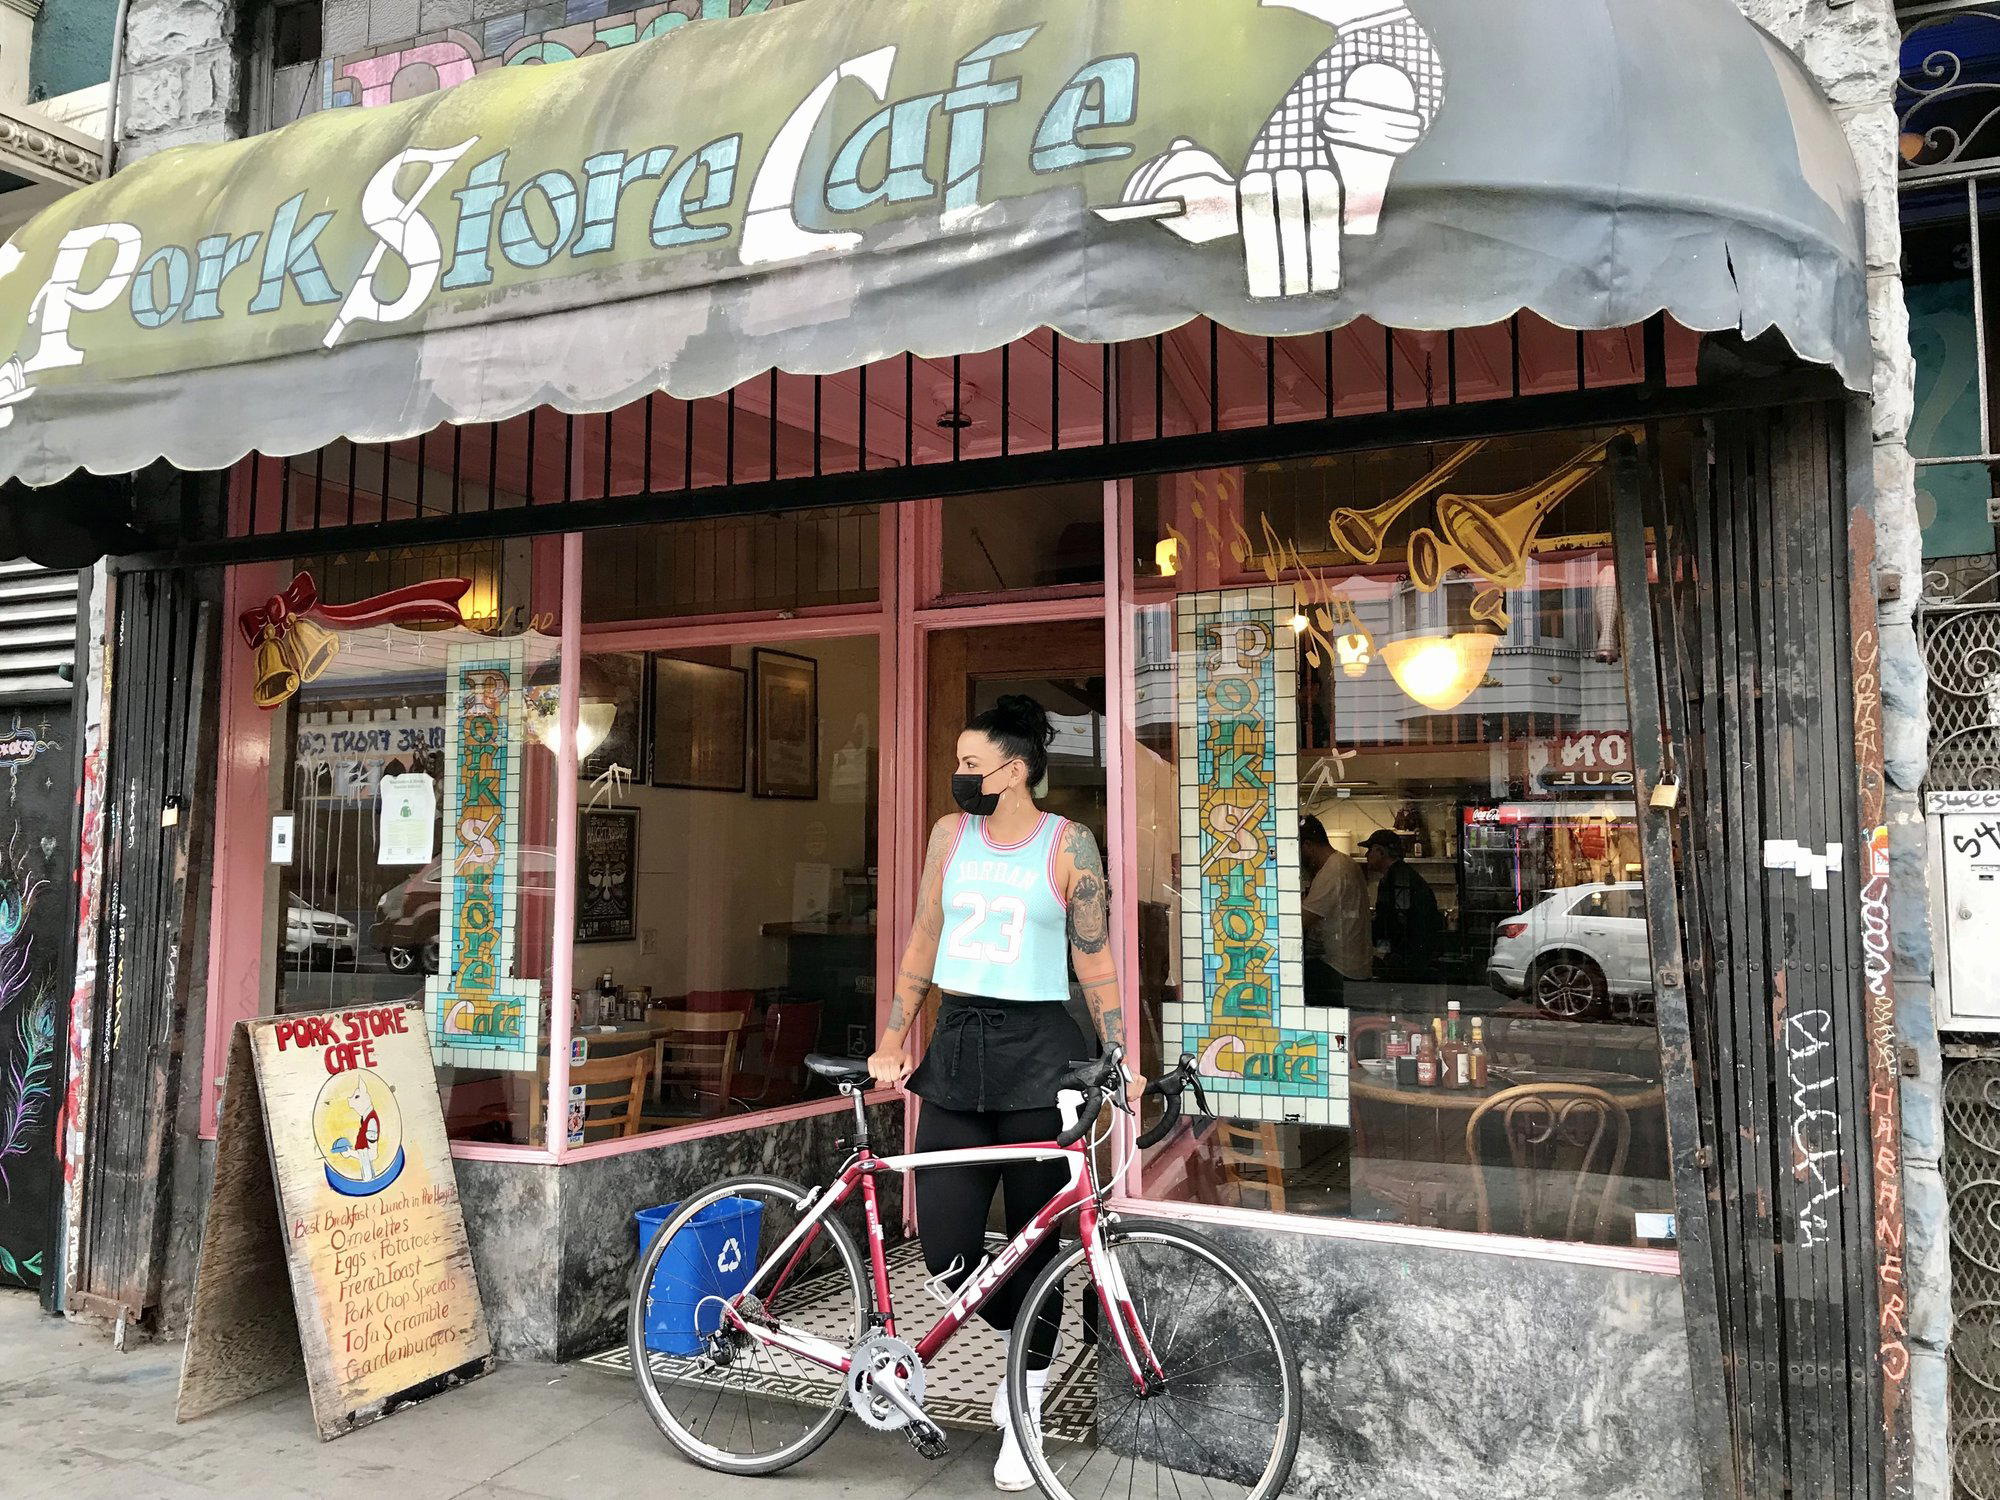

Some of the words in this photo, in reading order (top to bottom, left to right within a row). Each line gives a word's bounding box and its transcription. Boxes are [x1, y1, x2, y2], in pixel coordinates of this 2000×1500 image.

[25, 191, 342, 372] Pork
[322, 133, 743, 348] Store
[1205, 623, 1272, 788] Pork
[459, 670, 510, 807] Pork
[956, 860, 1041, 892] JORDAN
[454, 813, 503, 990] Store
[1201, 800, 1272, 1019] Store
[947, 890, 1027, 965] 23
[275, 1016, 342, 1051] PORK
[342, 1007, 409, 1041] STORE
[324, 1040, 378, 1075] CAFE
[1199, 1033, 1318, 1083] Café
[294, 1214, 320, 1239] Best
[379, 1191, 410, 1216] Lunch
[411, 1196, 420, 1208] in
[331, 1217, 409, 1251] Omelettes
[335, 1250, 367, 1281] Eggs
[340, 1267, 385, 1302] French
[386, 1256, 422, 1283] Toast
[943, 1215, 1046, 1322] TREK
[345, 1297, 374, 1326] Pork
[376, 1289, 410, 1313] Chop
[412, 1275, 457, 1306] Specials
[383, 1300, 450, 1341] Scramble
[342, 1324, 457, 1382] Gardenburgers
